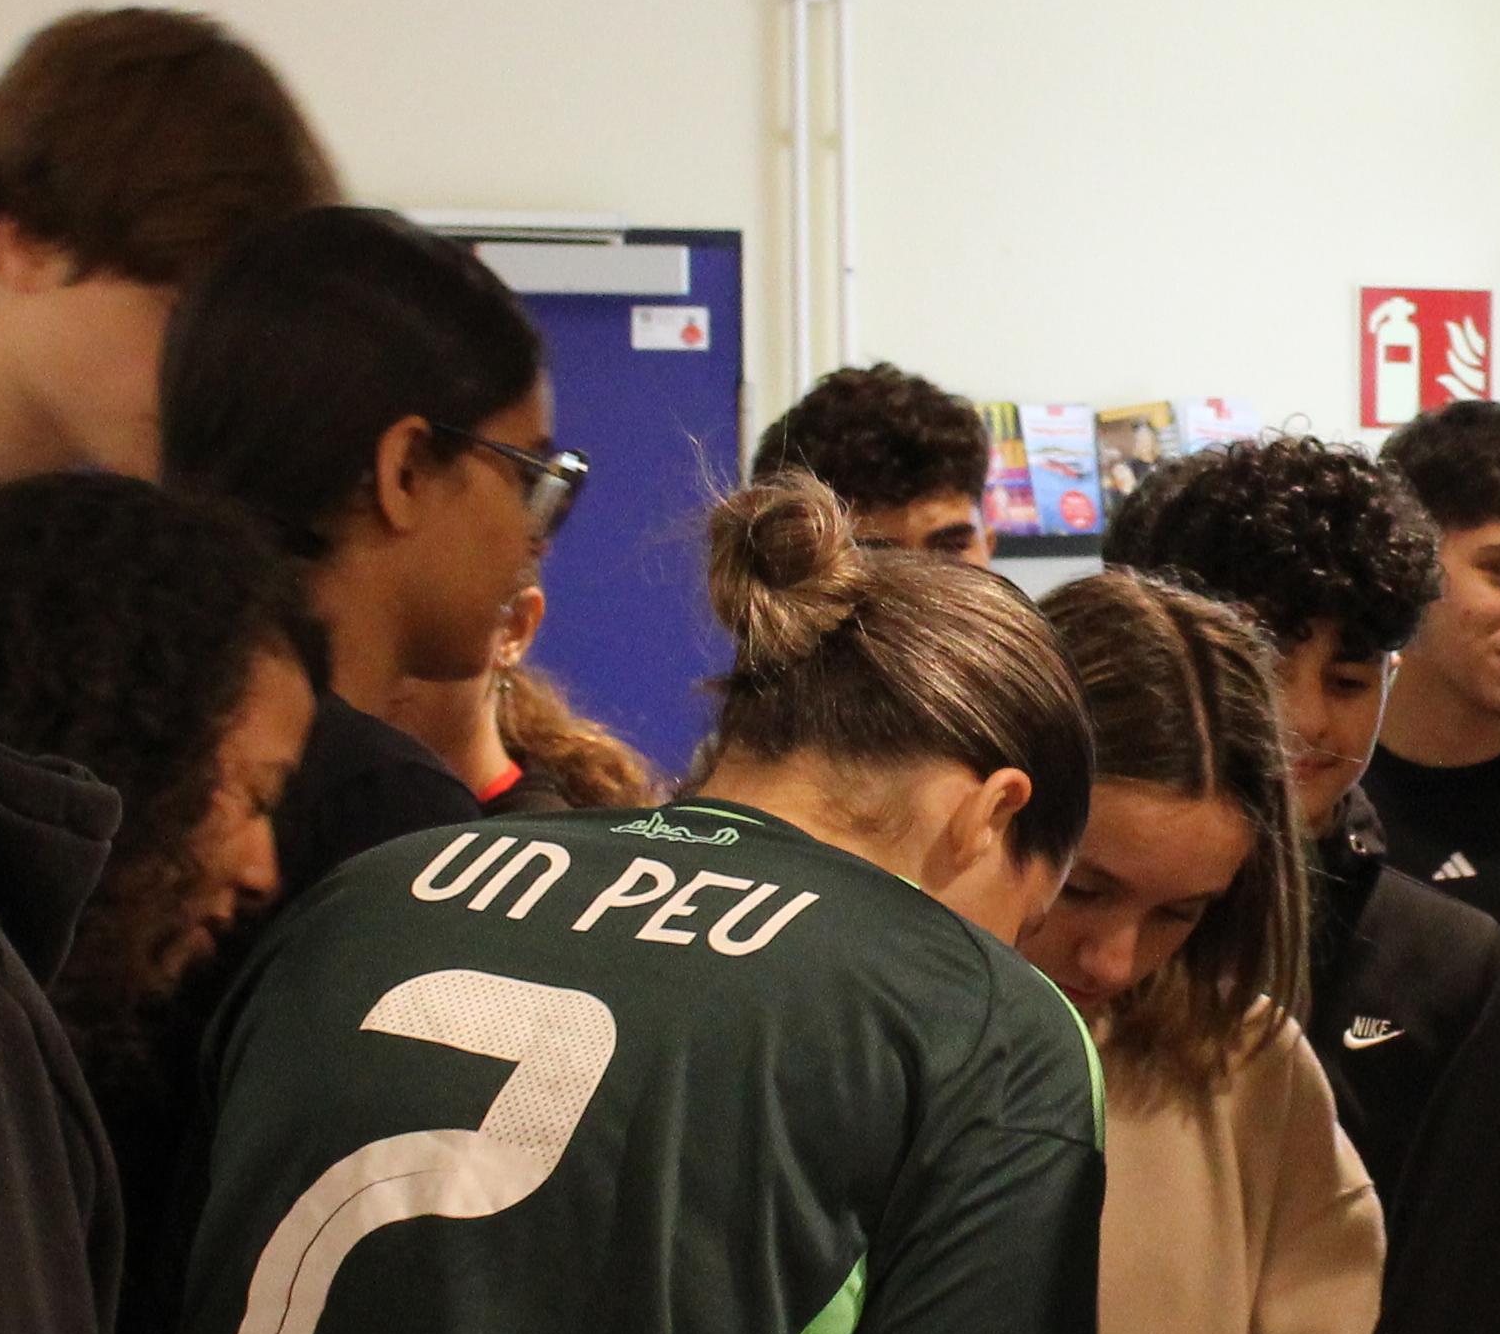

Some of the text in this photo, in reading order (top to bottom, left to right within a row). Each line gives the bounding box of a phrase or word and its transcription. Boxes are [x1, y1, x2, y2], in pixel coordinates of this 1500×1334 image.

[410, 831, 821, 958] UN PEU
[1353, 1016, 1392, 1039] NIKE
